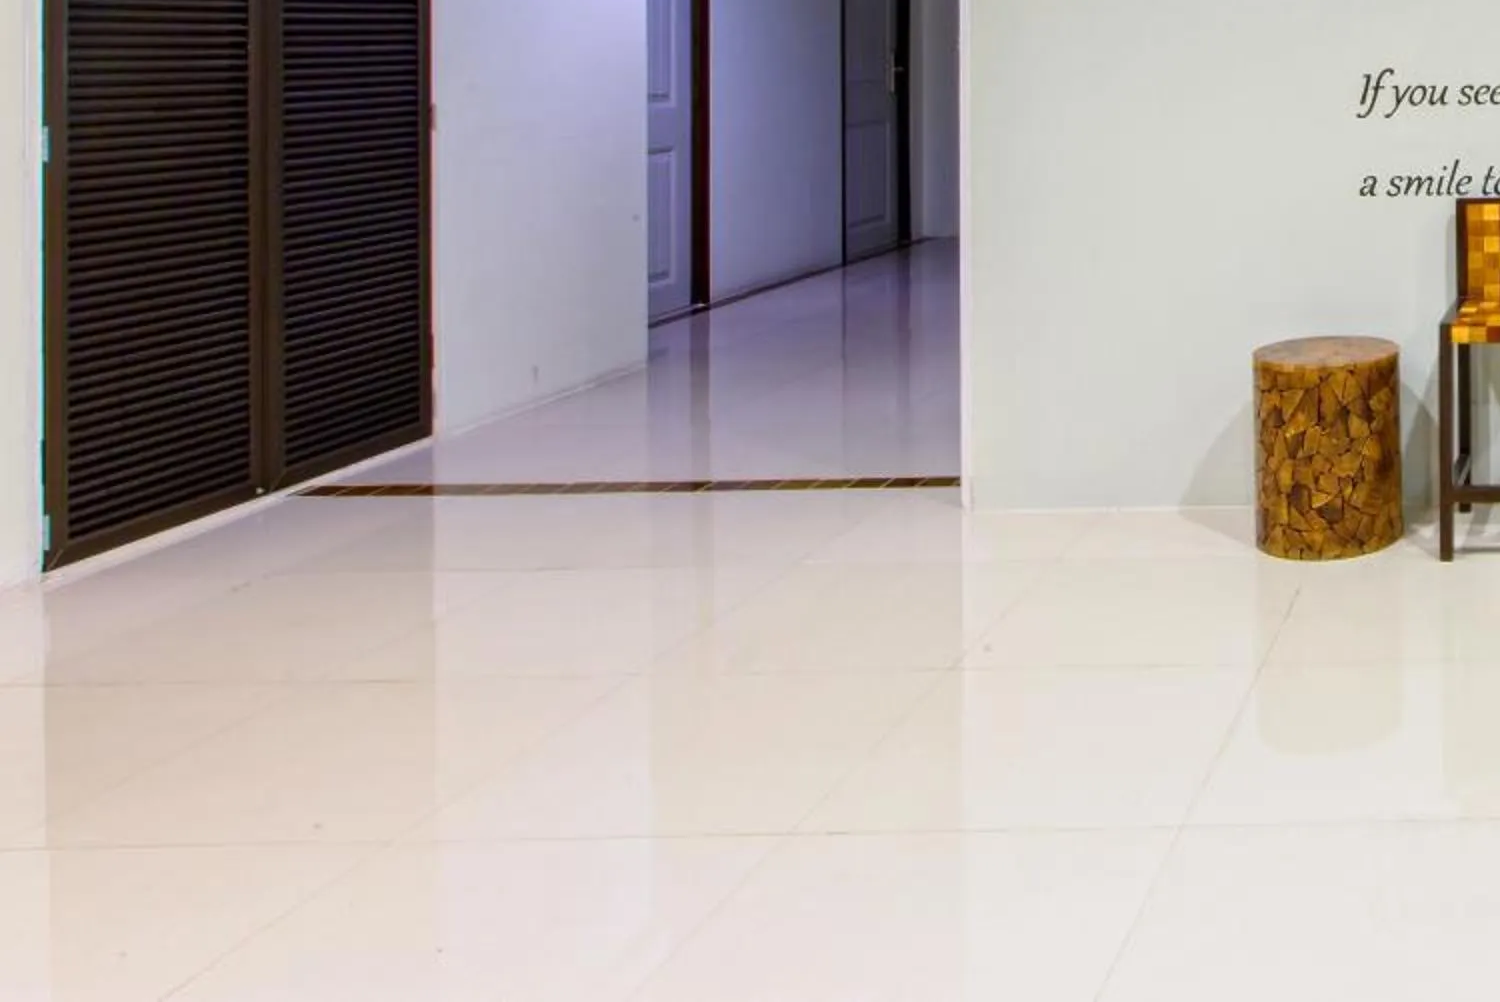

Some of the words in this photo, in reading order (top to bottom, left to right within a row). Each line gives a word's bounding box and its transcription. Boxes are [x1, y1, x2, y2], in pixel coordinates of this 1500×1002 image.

[1356, 67, 1395, 119] If
[1384, 81, 1449, 119] you
[1358, 174, 1378, 198] a
[1386, 158, 1474, 197] smile
